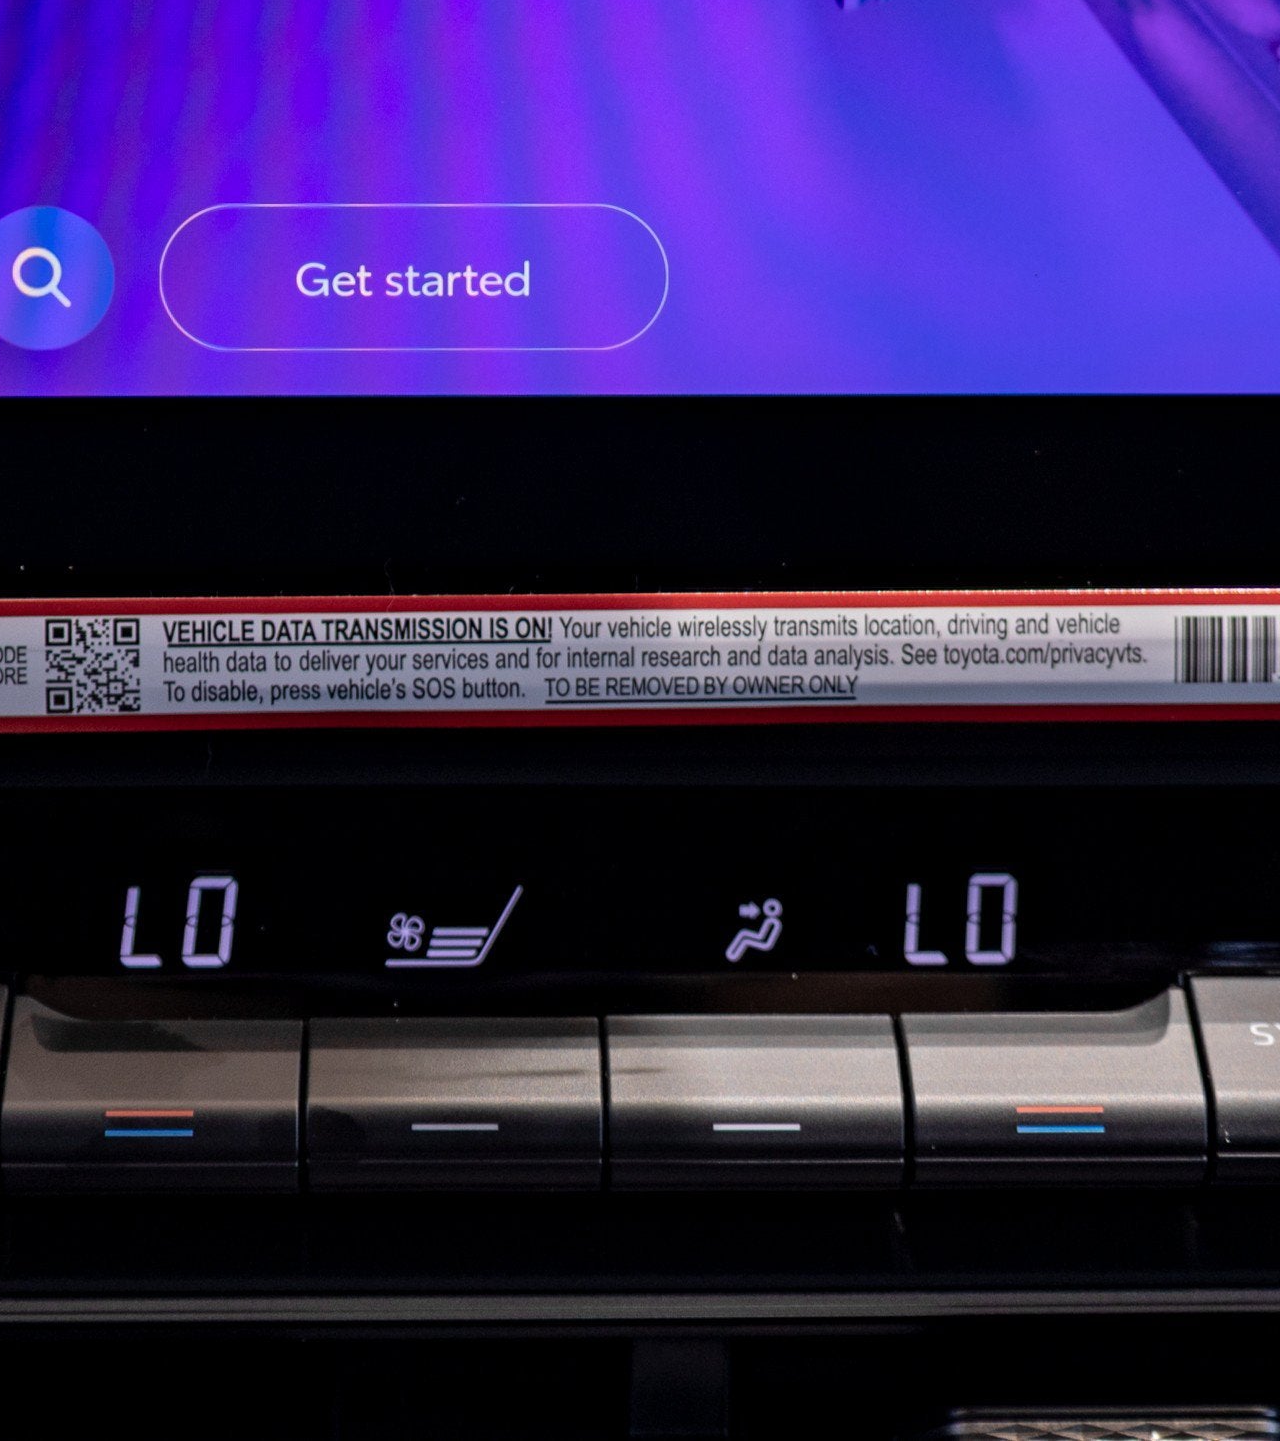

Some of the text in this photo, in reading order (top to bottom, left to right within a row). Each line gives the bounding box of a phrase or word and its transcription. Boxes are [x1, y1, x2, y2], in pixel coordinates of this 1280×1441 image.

[295, 259, 531, 298] Get started
[162, 612, 1121, 643] VEHICLE DATA TRANSMISSION IS ON! Your vehicle wirelessly transmits location, driving and vehicle
[162, 642, 1148, 676] health data to deliver your services and for internal research and data analysis. See toyota.com/privacyvts.
[162, 674, 859, 705] To disable, press vehicle's SOS button. TO BE REMOVED BY OWNER ONLY
[120, 874, 239, 969] LO
[903, 871, 1019, 966] LO
